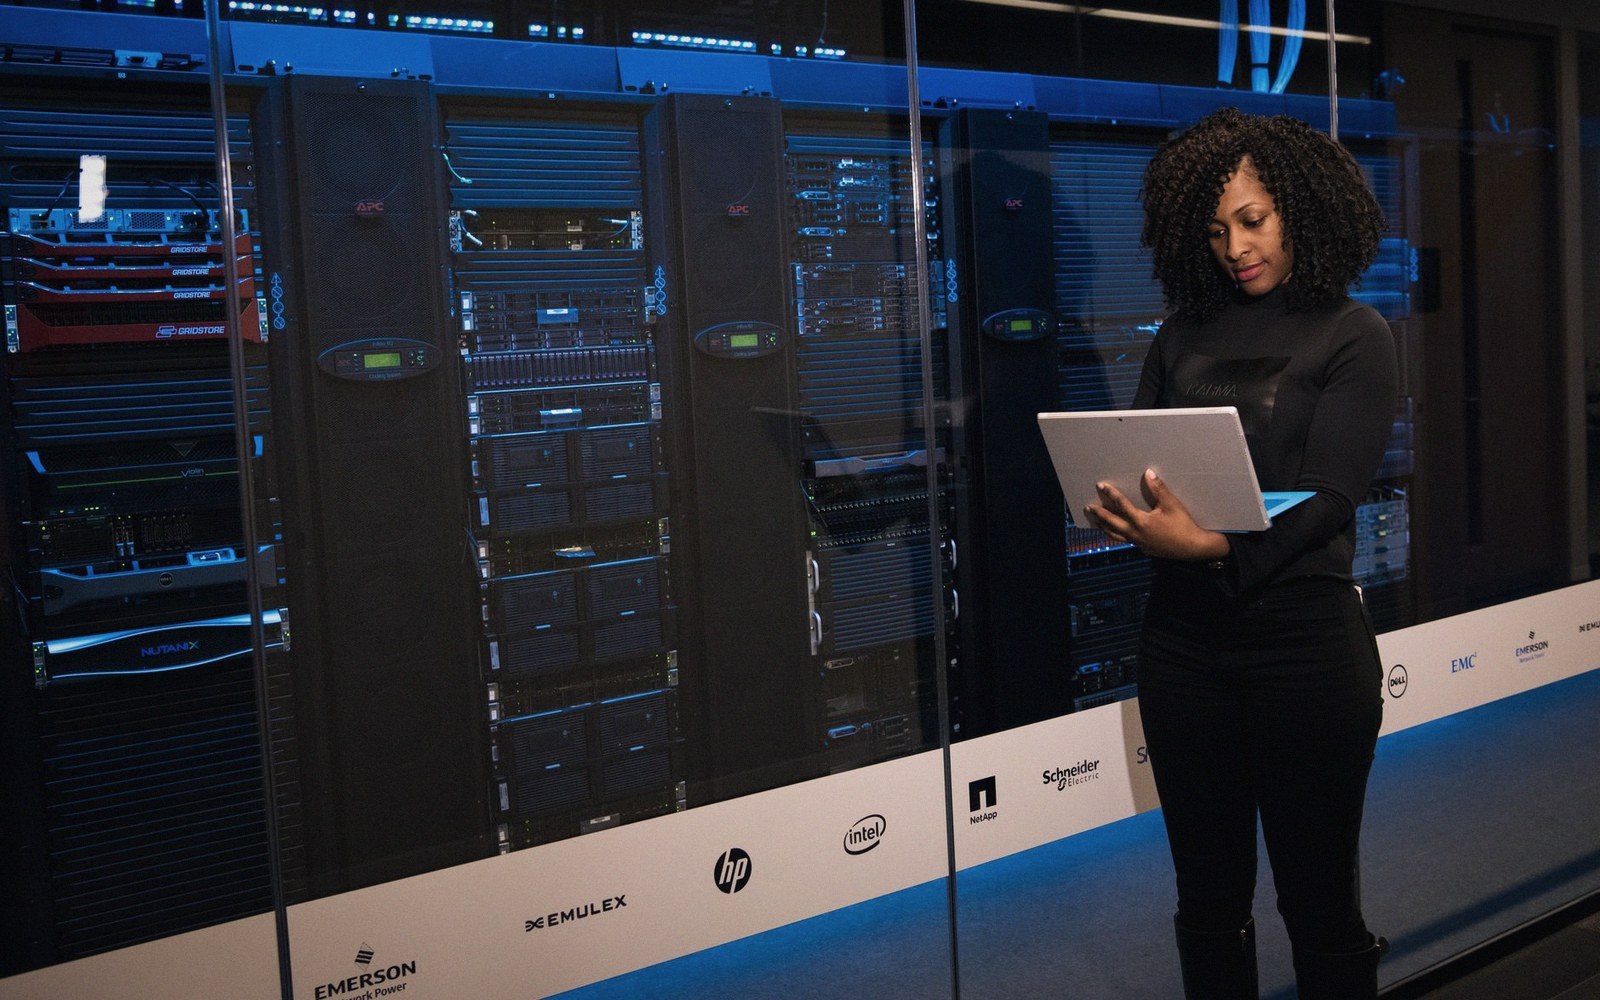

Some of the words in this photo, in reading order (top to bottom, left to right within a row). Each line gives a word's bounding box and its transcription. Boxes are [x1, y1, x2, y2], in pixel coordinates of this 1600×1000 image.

[356, 202, 384, 212] APC
[728, 205, 749, 213] APC
[1006, 199, 1023, 207] APC
[170, 246, 208, 254] GRIDSTORE
[172, 268, 209, 276] GRIDSTORE
[173, 291, 210, 299] GRIDSTORE
[178, 326, 225, 335] GRIDSTORE
[180, 467, 205, 477] Violin
[140, 640, 199, 657] NUTANIX
[1515, 640, 1549, 657] EMERSON
[1390, 676, 1405, 687] DELL
[1043, 759, 1099, 785] Schneider
[1068, 772, 1100, 787] Electric
[970, 811, 998, 825] NetApp
[717, 848, 750, 894] hp
[547, 894, 627, 927] EMULEX
[314, 961, 416, 1000] EMERSON
[374, 982, 407, 998] Power
